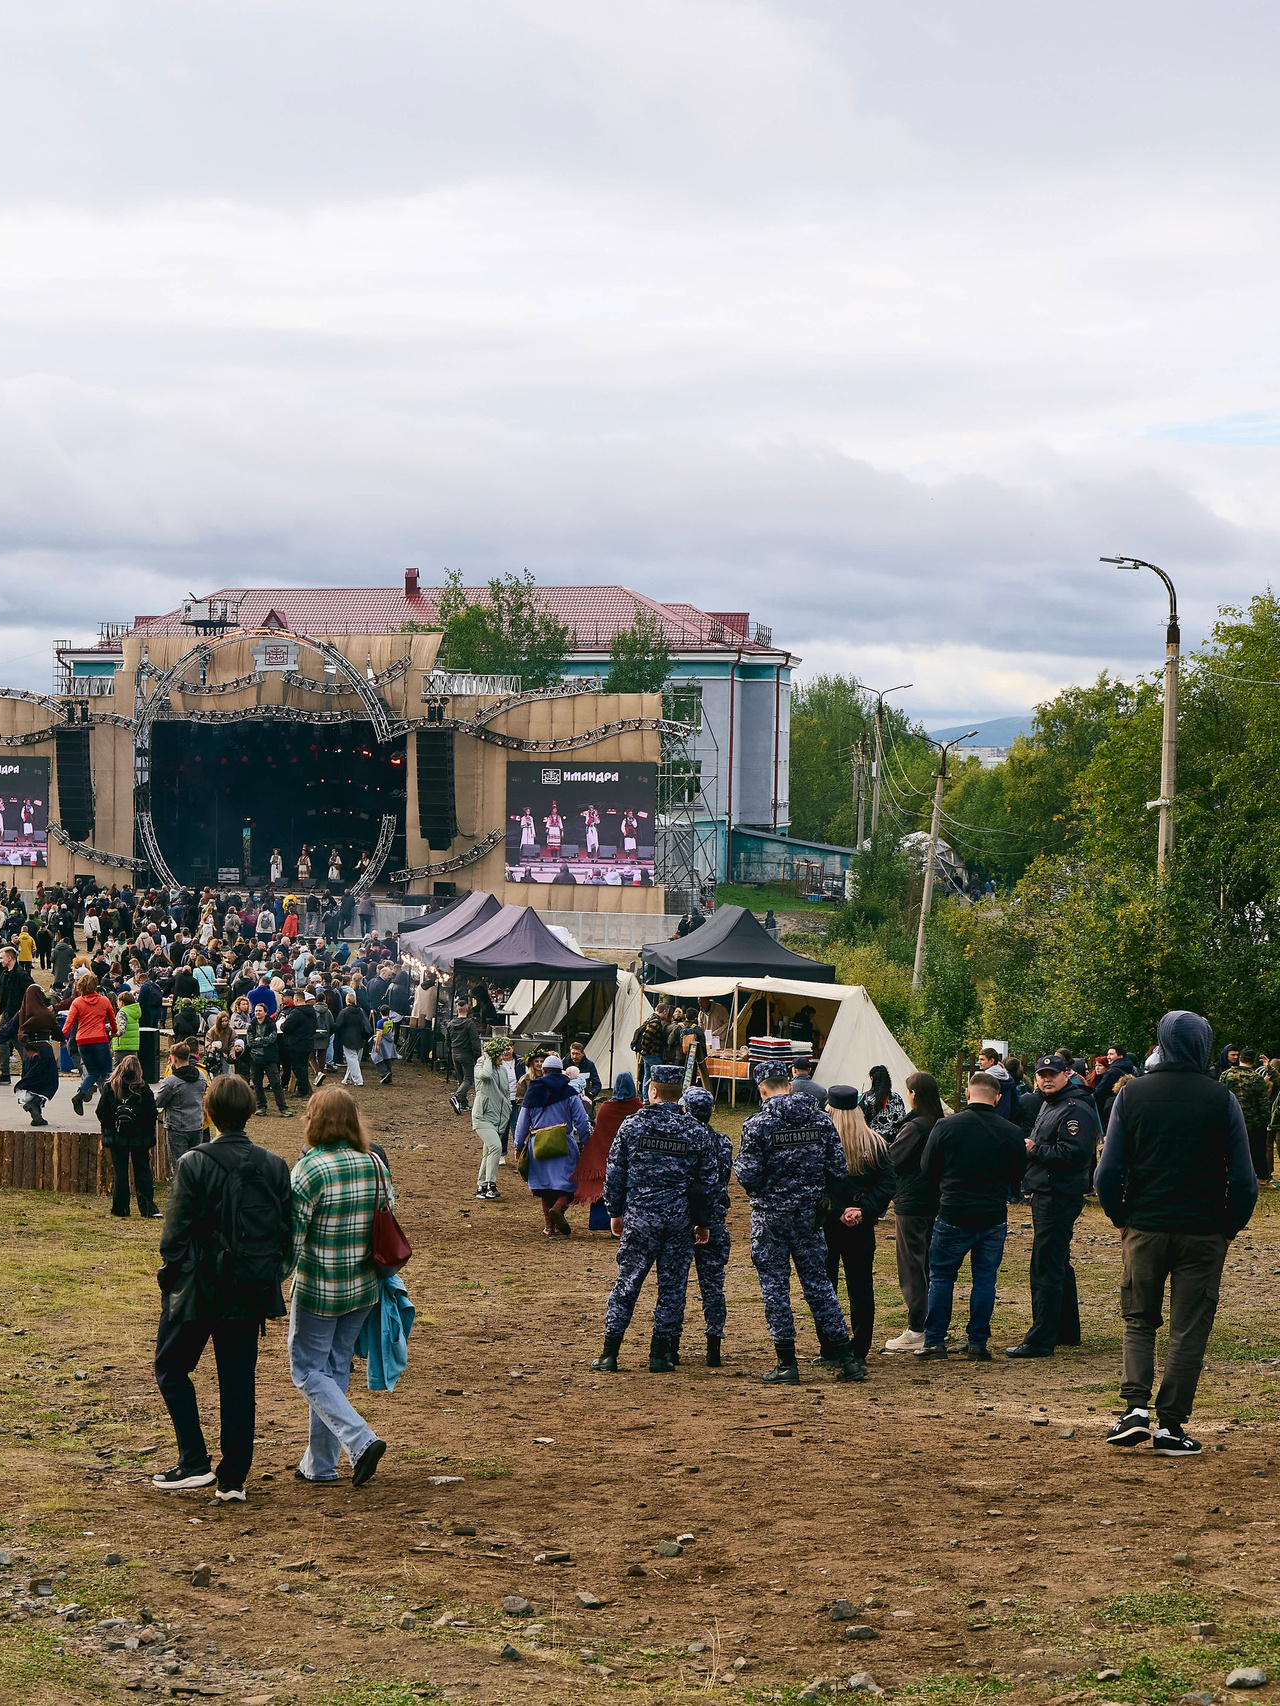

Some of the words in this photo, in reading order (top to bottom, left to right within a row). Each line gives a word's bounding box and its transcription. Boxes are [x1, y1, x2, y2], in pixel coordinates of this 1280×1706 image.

[563, 771, 619, 783] ИМАНДРА
[775, 1130, 819, 1143] РОСГВАРДИЯ
[642, 1138, 687, 1152] РОСГВАРДИЯ
